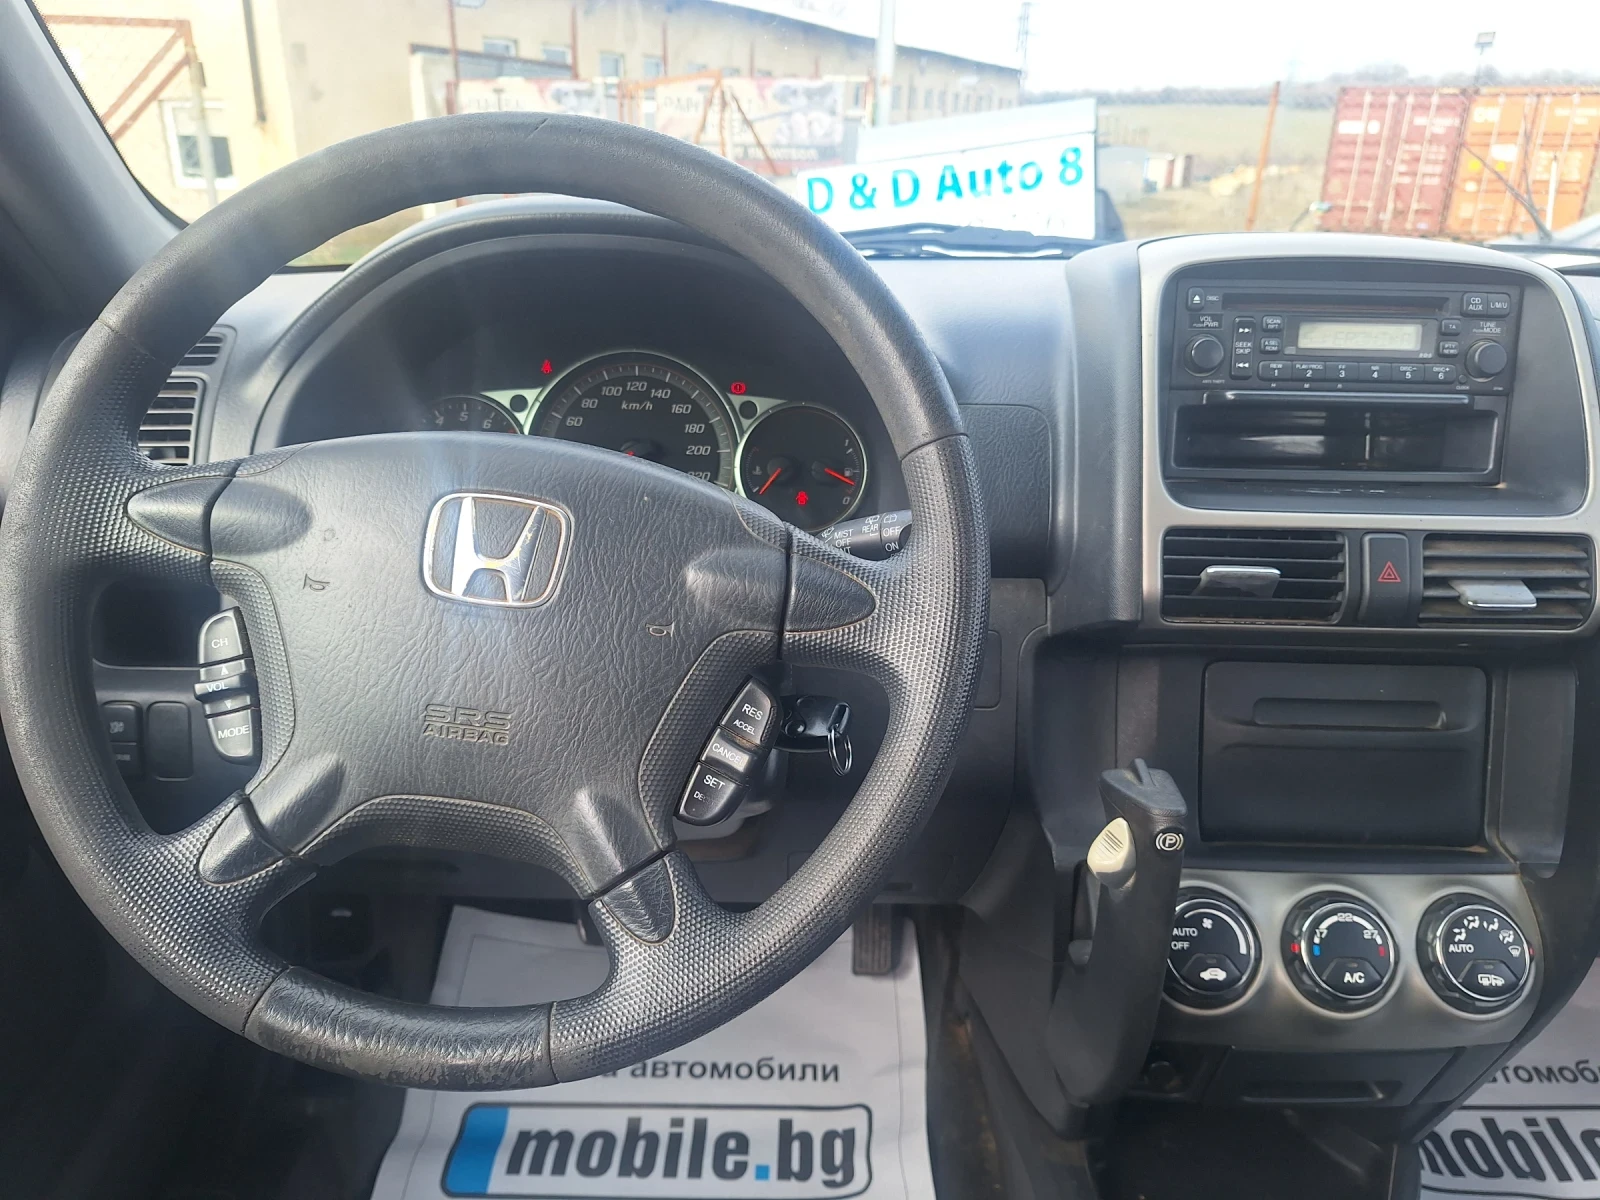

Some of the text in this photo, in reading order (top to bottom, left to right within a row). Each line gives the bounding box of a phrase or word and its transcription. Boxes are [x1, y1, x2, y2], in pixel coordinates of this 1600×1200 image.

[807, 147, 1083, 214] D & D Auto 8
[1274, 369, 1279, 377] 1
[1306, 369, 1313, 378] 2
[1339, 370, 1346, 378] 3
[1372, 371, 1379, 379] 4
[1405, 371, 1412, 379] 5
[1438, 372, 1445, 380] 6
[601, 386, 622, 396] 100
[626, 381, 648, 391] 120
[650, 389, 671, 399] 140
[581, 399, 598, 409] 80
[621, 400, 653, 411] km/h
[671, 404, 692, 414] 160
[436, 416, 445, 426] 4
[459, 411, 469, 422] 5
[566, 416, 583, 427] 60
[483, 419, 493, 429] 6
[684, 423, 705, 434] 180
[686, 445, 711, 456] 200
[862, 523, 878, 533] REAR
[883, 525, 901, 537] OFF
[834, 528, 854, 539] MIST
[836, 539, 851, 548] OFF
[885, 541, 900, 552] ON
[211, 637, 229, 649] CH
[206, 682, 229, 693] VOL
[742, 703, 764, 721] RES
[425, 703, 512, 732] SRS
[218, 725, 250, 739] MODE
[733, 719, 755, 736] ACCEL
[423, 723, 509, 746] AIRBAG
[703, 774, 726, 790] SET
[1337, 913, 1354, 922] 22
[1172, 927, 1198, 937] AUTO
[1316, 929, 1328, 939] 17
[1363, 929, 1378, 939] 27
[1170, 941, 1190, 950] OFF
[1449, 944, 1474, 953] AUTO
[1343, 972, 1365, 983] A/C
[630, 1057, 840, 1083] автомобили
[507, 1117, 855, 1188] mobile.bg
